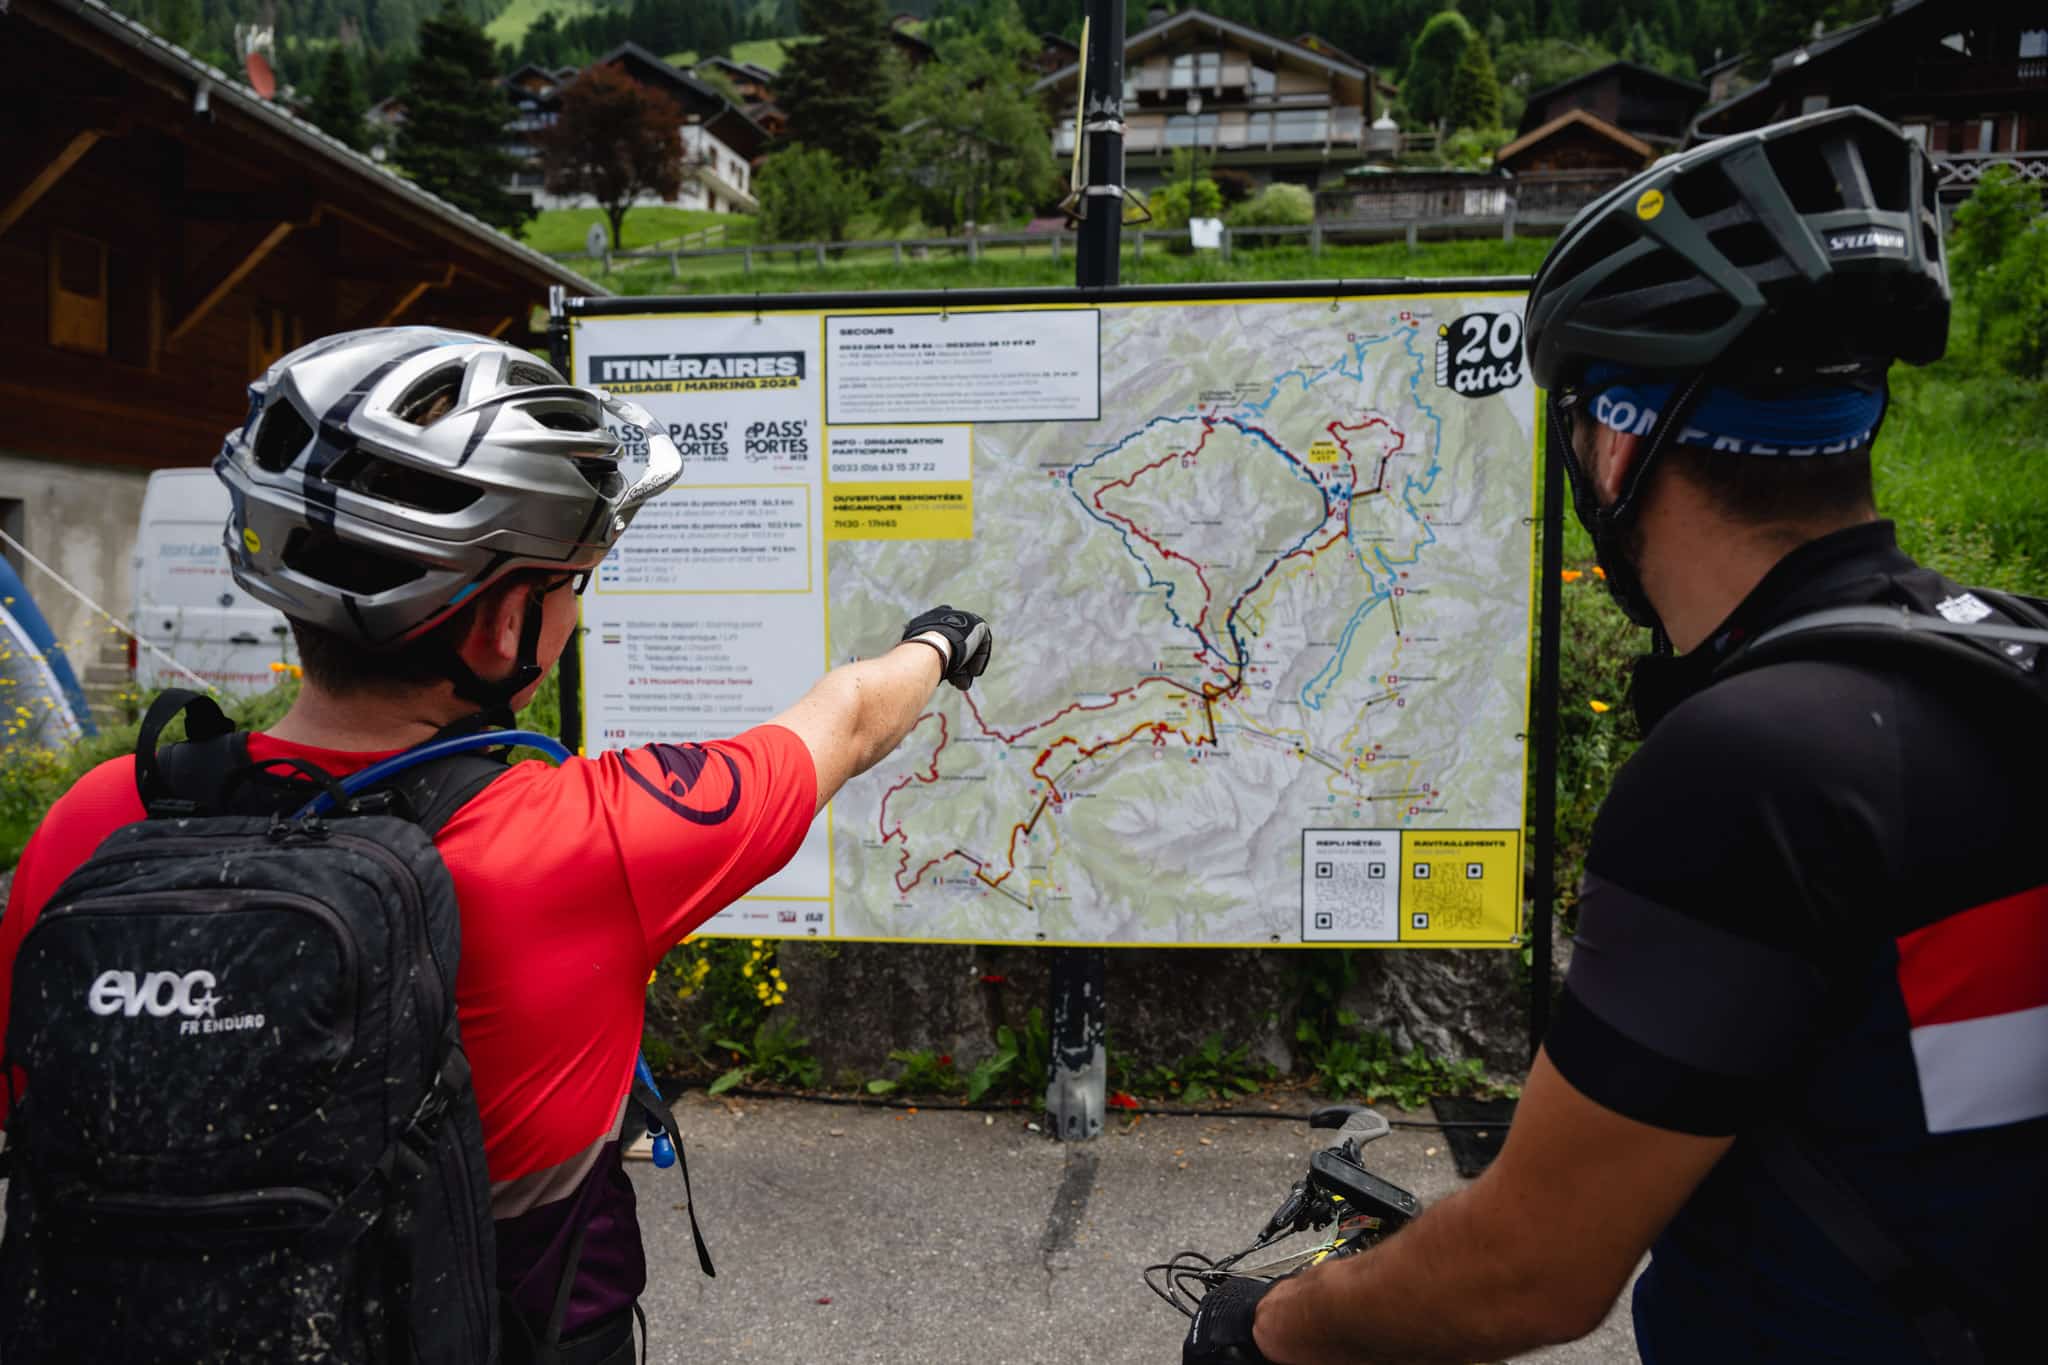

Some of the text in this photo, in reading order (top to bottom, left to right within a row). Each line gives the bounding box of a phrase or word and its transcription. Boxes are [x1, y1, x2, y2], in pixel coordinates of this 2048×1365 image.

[1456, 312, 1520, 365] 20
[603, 354, 797, 380] ITINÉRAIRES
[1454, 361, 1521, 392] ans
[685, 380, 756, 391] MARKING
[759, 378, 797, 388] 2024
[745, 438, 808, 454] PORTES
[864, 438, 944, 446] ORGANISATION
[88, 969, 219, 1018] evoc
[180, 1014, 265, 1035] FR ENDURO
